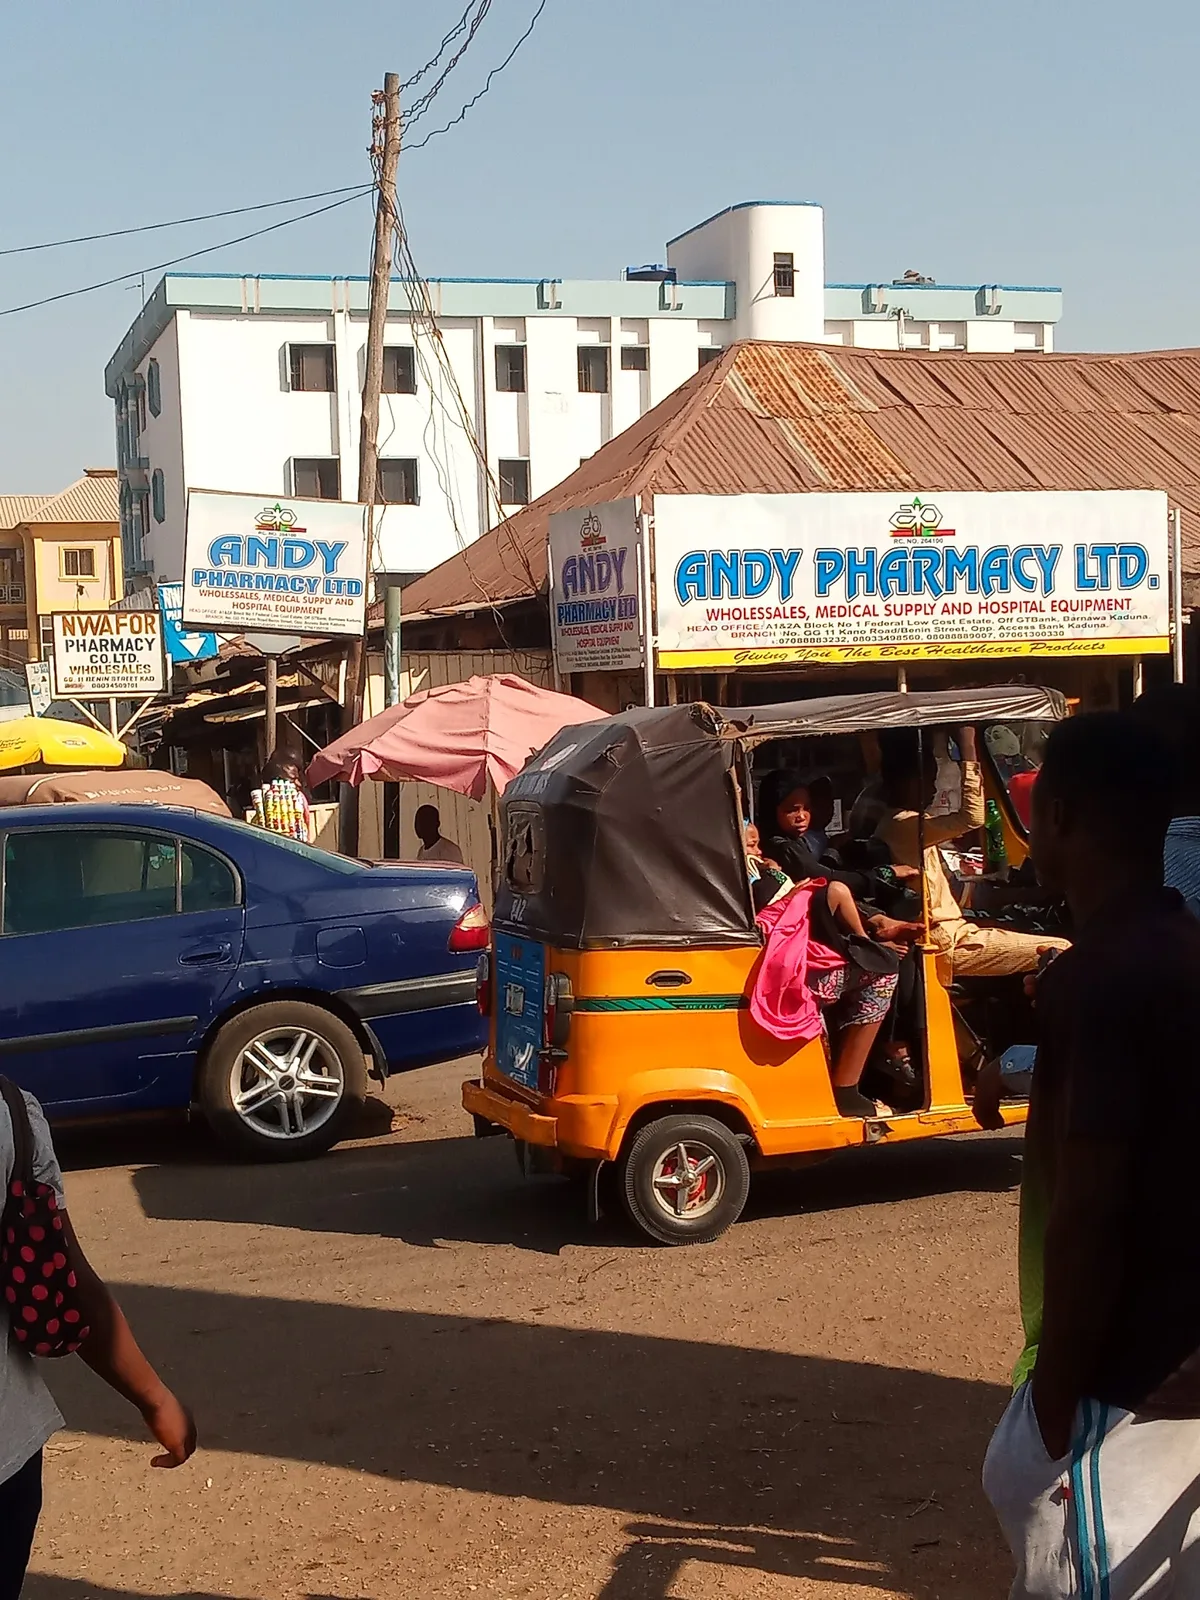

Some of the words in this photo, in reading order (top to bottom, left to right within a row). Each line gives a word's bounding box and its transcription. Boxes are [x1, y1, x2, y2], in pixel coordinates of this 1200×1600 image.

[207, 534, 349, 576] ANDY
[192, 568, 322, 596] PHARMACY
[323, 576, 363, 598] LTD
[561, 547, 627, 601] ANDY
[674, 548, 803, 606] ANDY
[814, 543, 1063, 602] PHARMACY
[1074, 542, 1160, 592] LTD.
[199, 589, 261, 601] WHOLESSALES,
[264, 594, 301, 604] MEDICAL
[303, 596, 334, 606] SUPPLY
[335, 598, 354, 606] AND
[232, 601, 272, 612] HOSPITAL
[275, 604, 324, 615] EQUIPMENT
[557, 597, 618, 626] PHARMACY
[618, 594, 638, 620] LTD
[706, 606, 810, 621] WHOLESSALES,
[815, 604, 879, 618] MEDICAL
[884, 602, 937, 617] SUPPLY
[941, 602, 973, 615] AND
[978, 600, 1046, 615] HOSPITAL
[1050, 598, 1132, 613] EQUIPMENT
[1063, 614, 1107, 622] Barnawa
[62, 613, 157, 636] NWAFOR
[839, 628, 867, 636] Kano
[870, 626, 931, 634] Road/Benin
[65, 637, 156, 653] PHARMACY
[733, 650, 788, 664] Giving
[794, 648, 832, 661] You
[838, 647, 872, 658] The
[879, 646, 920, 656] Best
[924, 644, 1022, 655] Healthcare
[1026, 641, 1106, 653] Products
[69, 664, 151, 675] WHOLESALES
